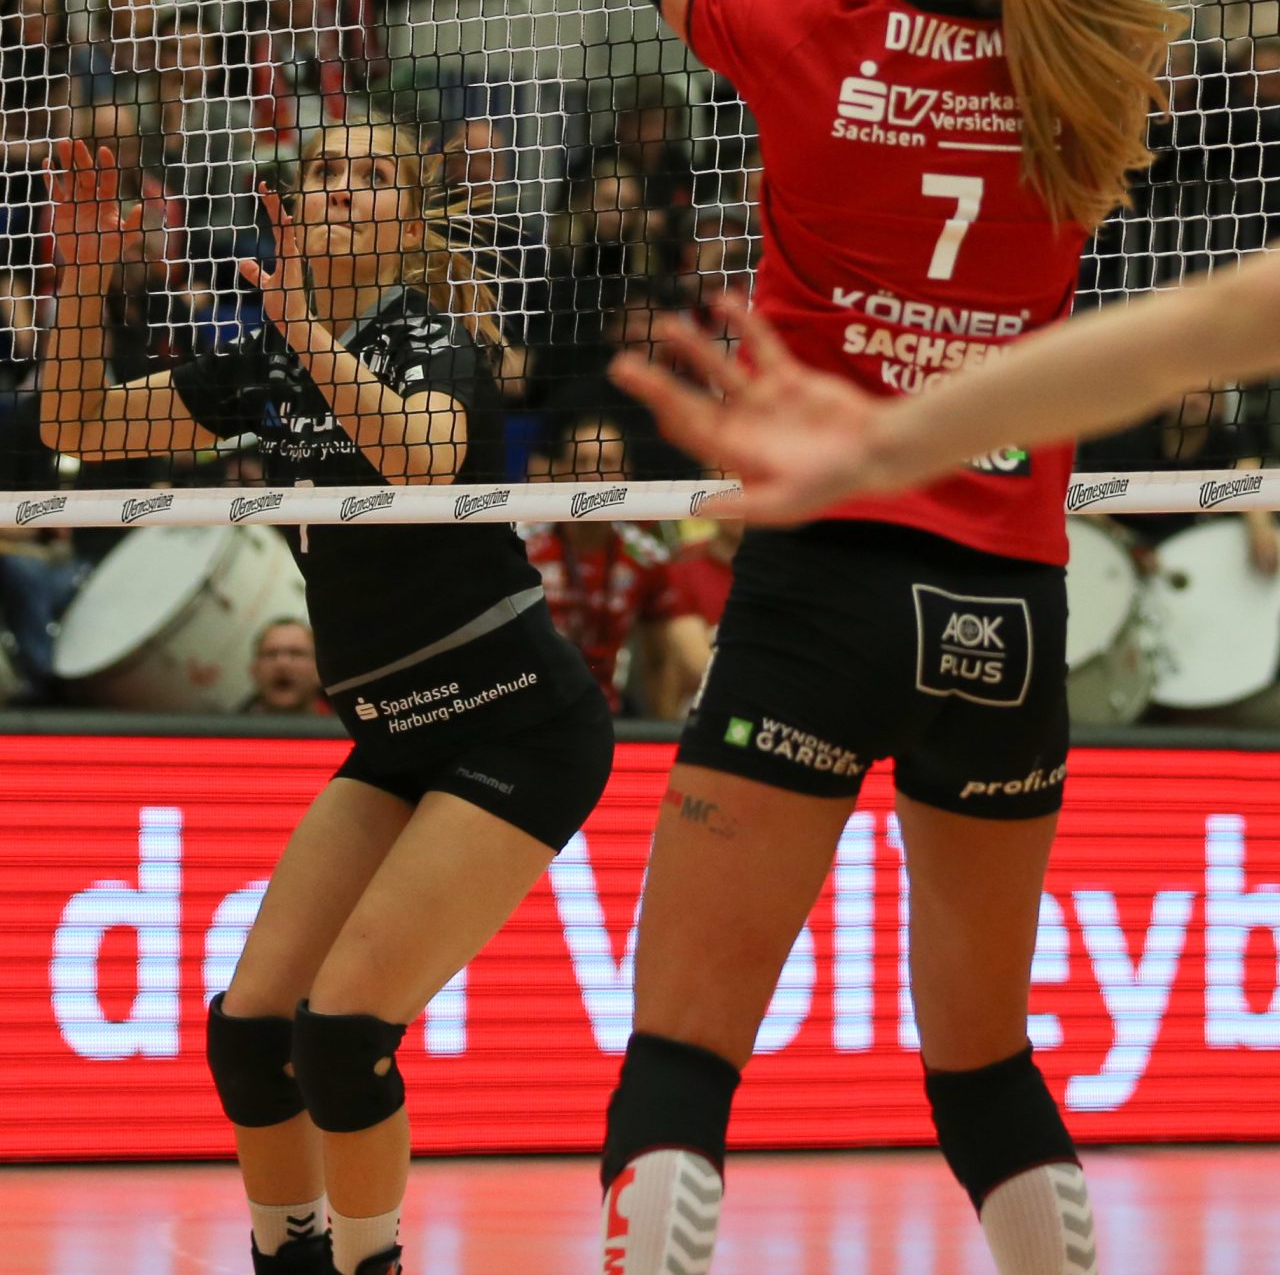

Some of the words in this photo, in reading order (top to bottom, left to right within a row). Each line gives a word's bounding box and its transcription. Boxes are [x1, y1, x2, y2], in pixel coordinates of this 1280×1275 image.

[831, 119, 926, 147] Sachsen
[921, 173, 984, 280] 7
[454, 487, 511, 520] Wernesgrüner
[570, 486, 628, 518] Wernesgrüner
[1066, 477, 1130, 511] Wernesgrüner
[1198, 474, 1264, 509] Wernesgrüner
[942, 612, 1006, 650] AOK
[939, 654, 1004, 684] PLUS
[380, 681, 460, 716] Sparkasse
[388, 672, 538, 734] Harburg-Buxtehude
[756, 730, 864, 777] GARDEN
